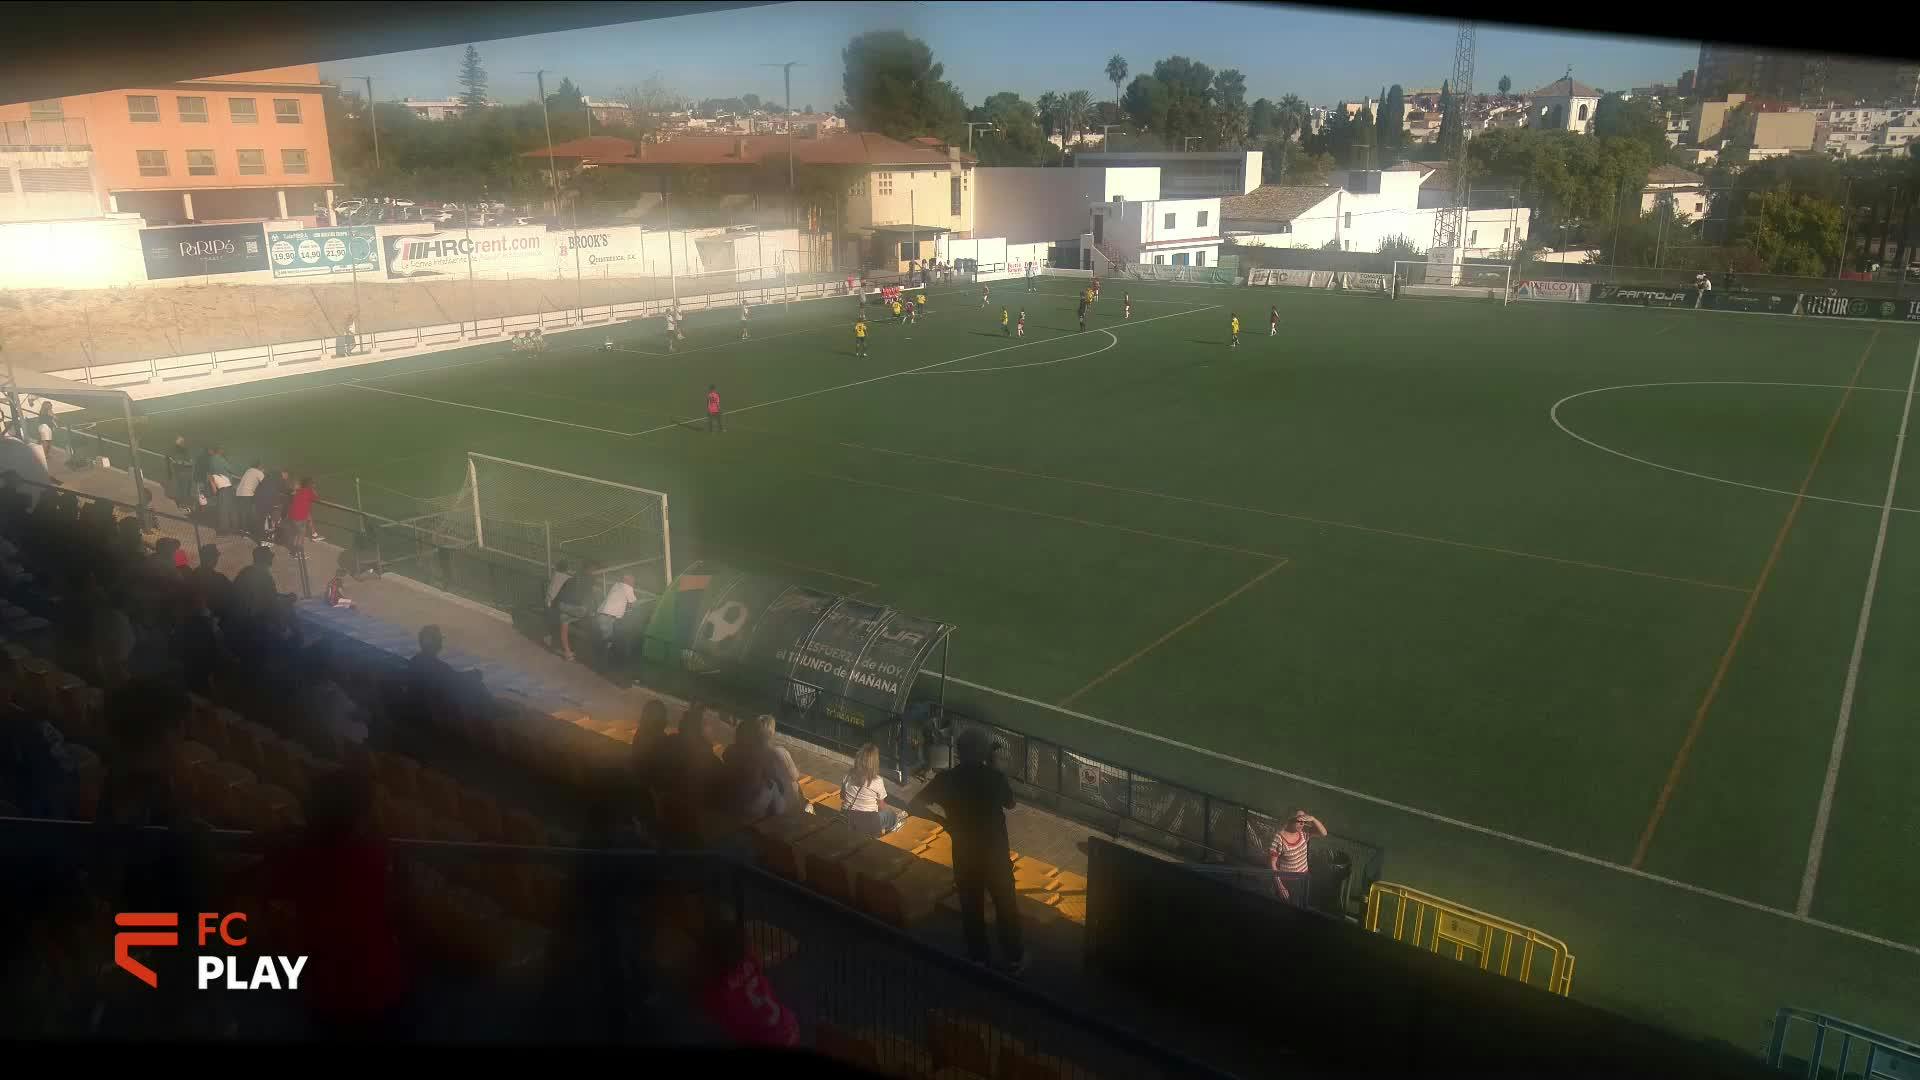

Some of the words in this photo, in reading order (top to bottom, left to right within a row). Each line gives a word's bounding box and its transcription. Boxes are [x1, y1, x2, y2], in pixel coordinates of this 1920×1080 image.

[568, 234, 608, 249] BROOK'S
[1617, 289, 1686, 301] PANTOJA
[833, 666, 848, 678] de
[849, 670, 898, 695] MAÑANA
